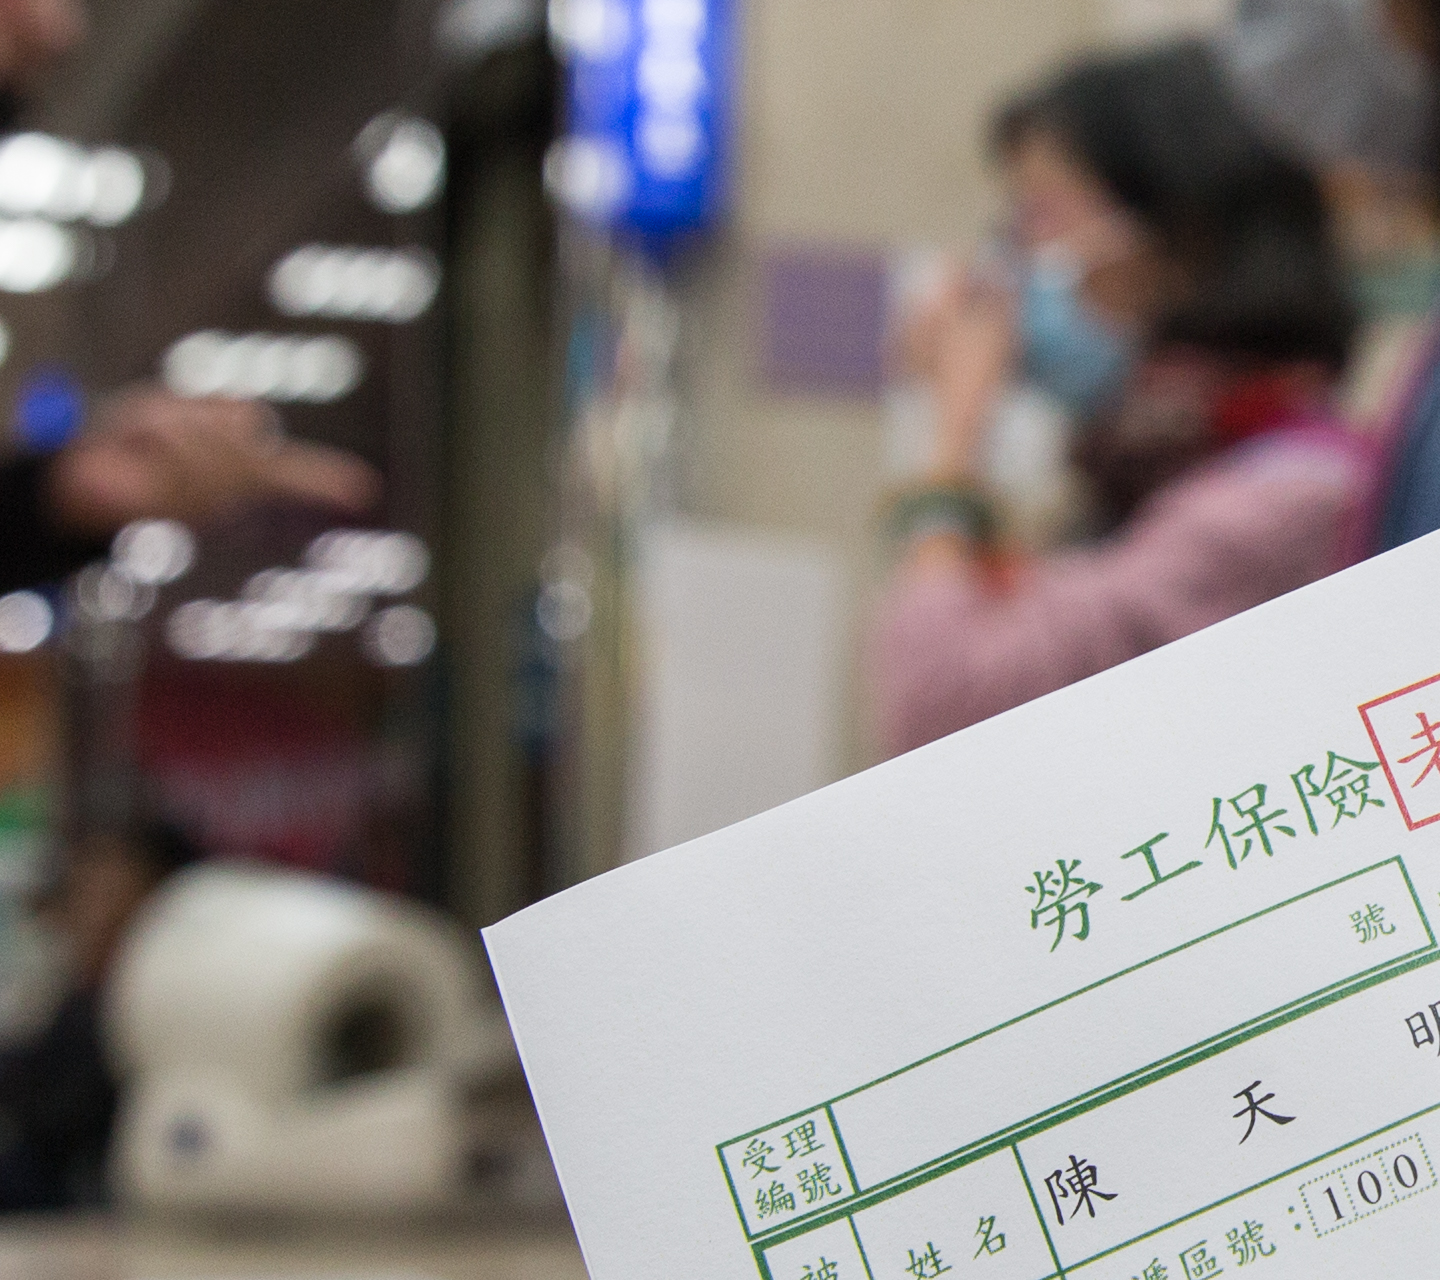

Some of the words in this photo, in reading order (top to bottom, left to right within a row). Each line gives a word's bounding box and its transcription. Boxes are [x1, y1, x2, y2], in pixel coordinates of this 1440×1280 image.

[1349, 904, 1396, 944] 號
[742, 1120, 825, 1179] 受理
[754, 1162, 842, 1219] 編號
[1324, 1154, 1418, 1220] 100
